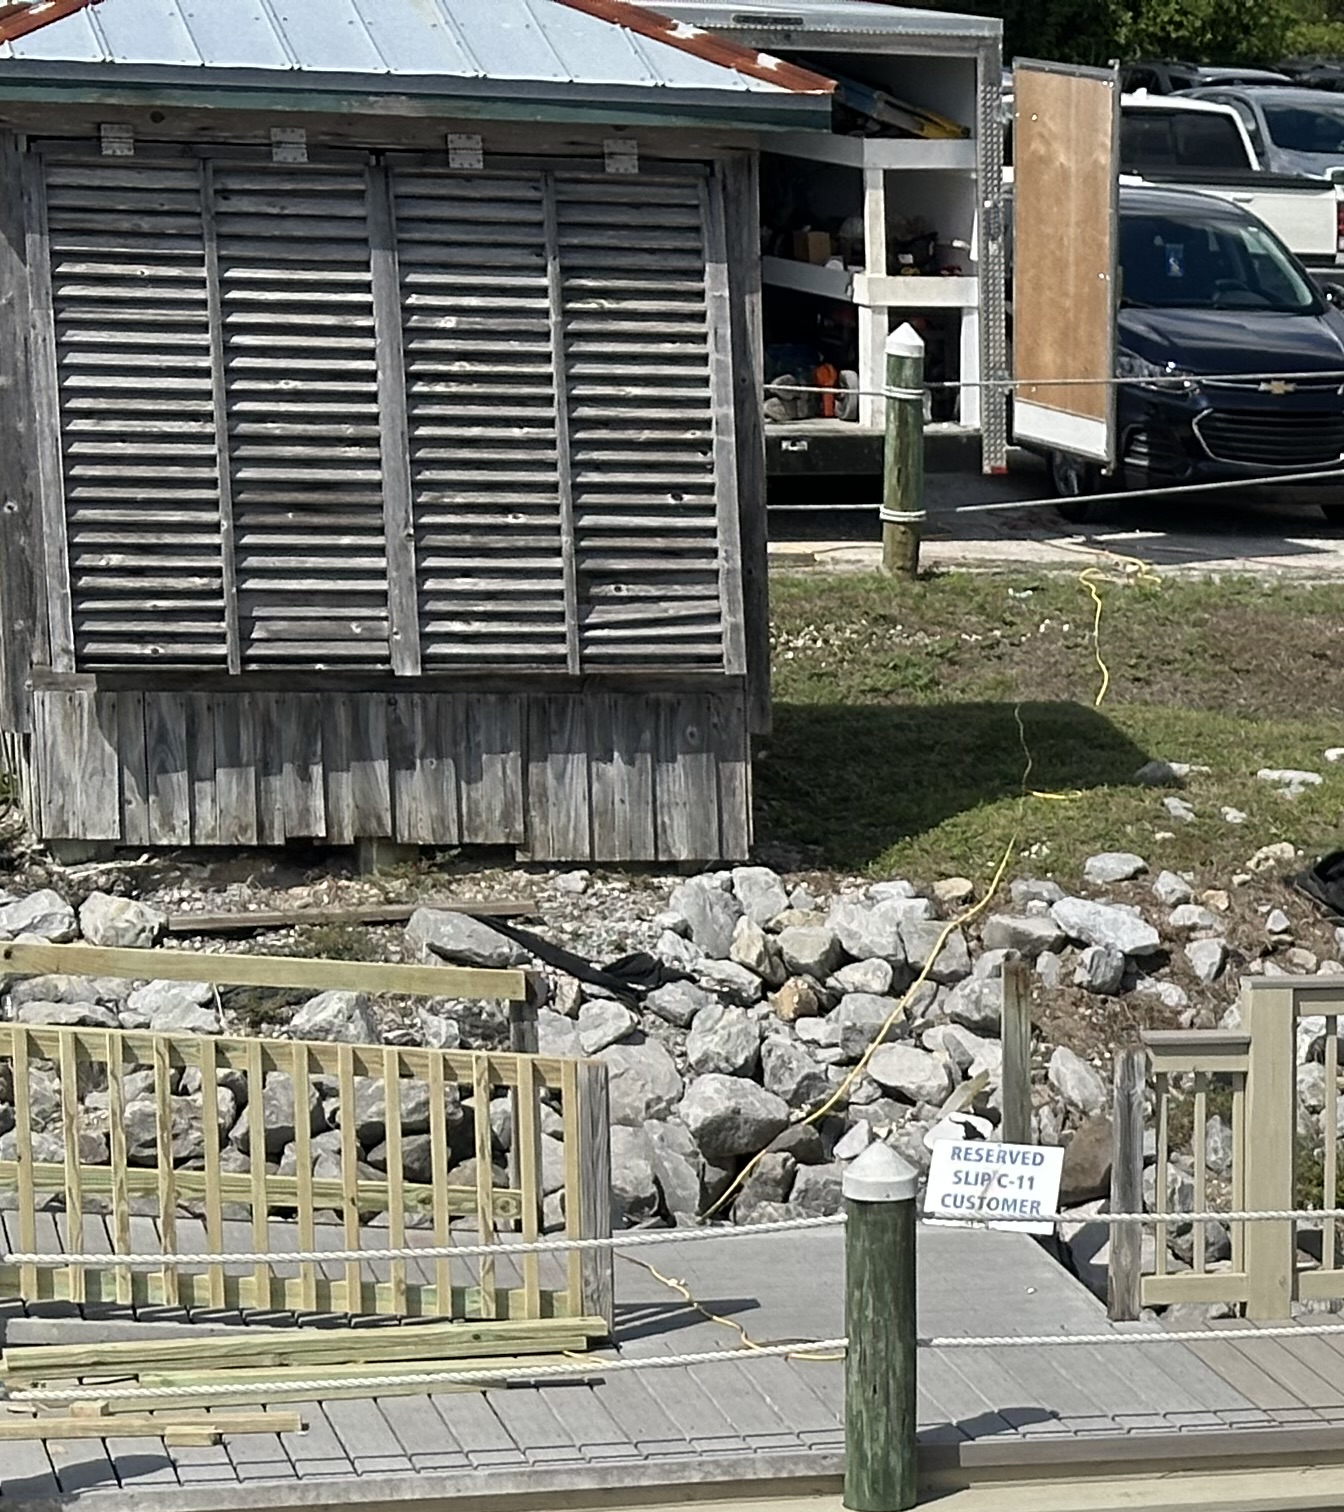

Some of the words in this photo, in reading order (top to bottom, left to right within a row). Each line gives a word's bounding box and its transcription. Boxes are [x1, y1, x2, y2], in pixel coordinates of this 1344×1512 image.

[950, 1146, 1045, 1167] RESERVED
[952, 1170, 991, 1187] SLIP
[997, 1173, 1035, 1191] C-11
[940, 1193, 1042, 1216] CUSTOMER
